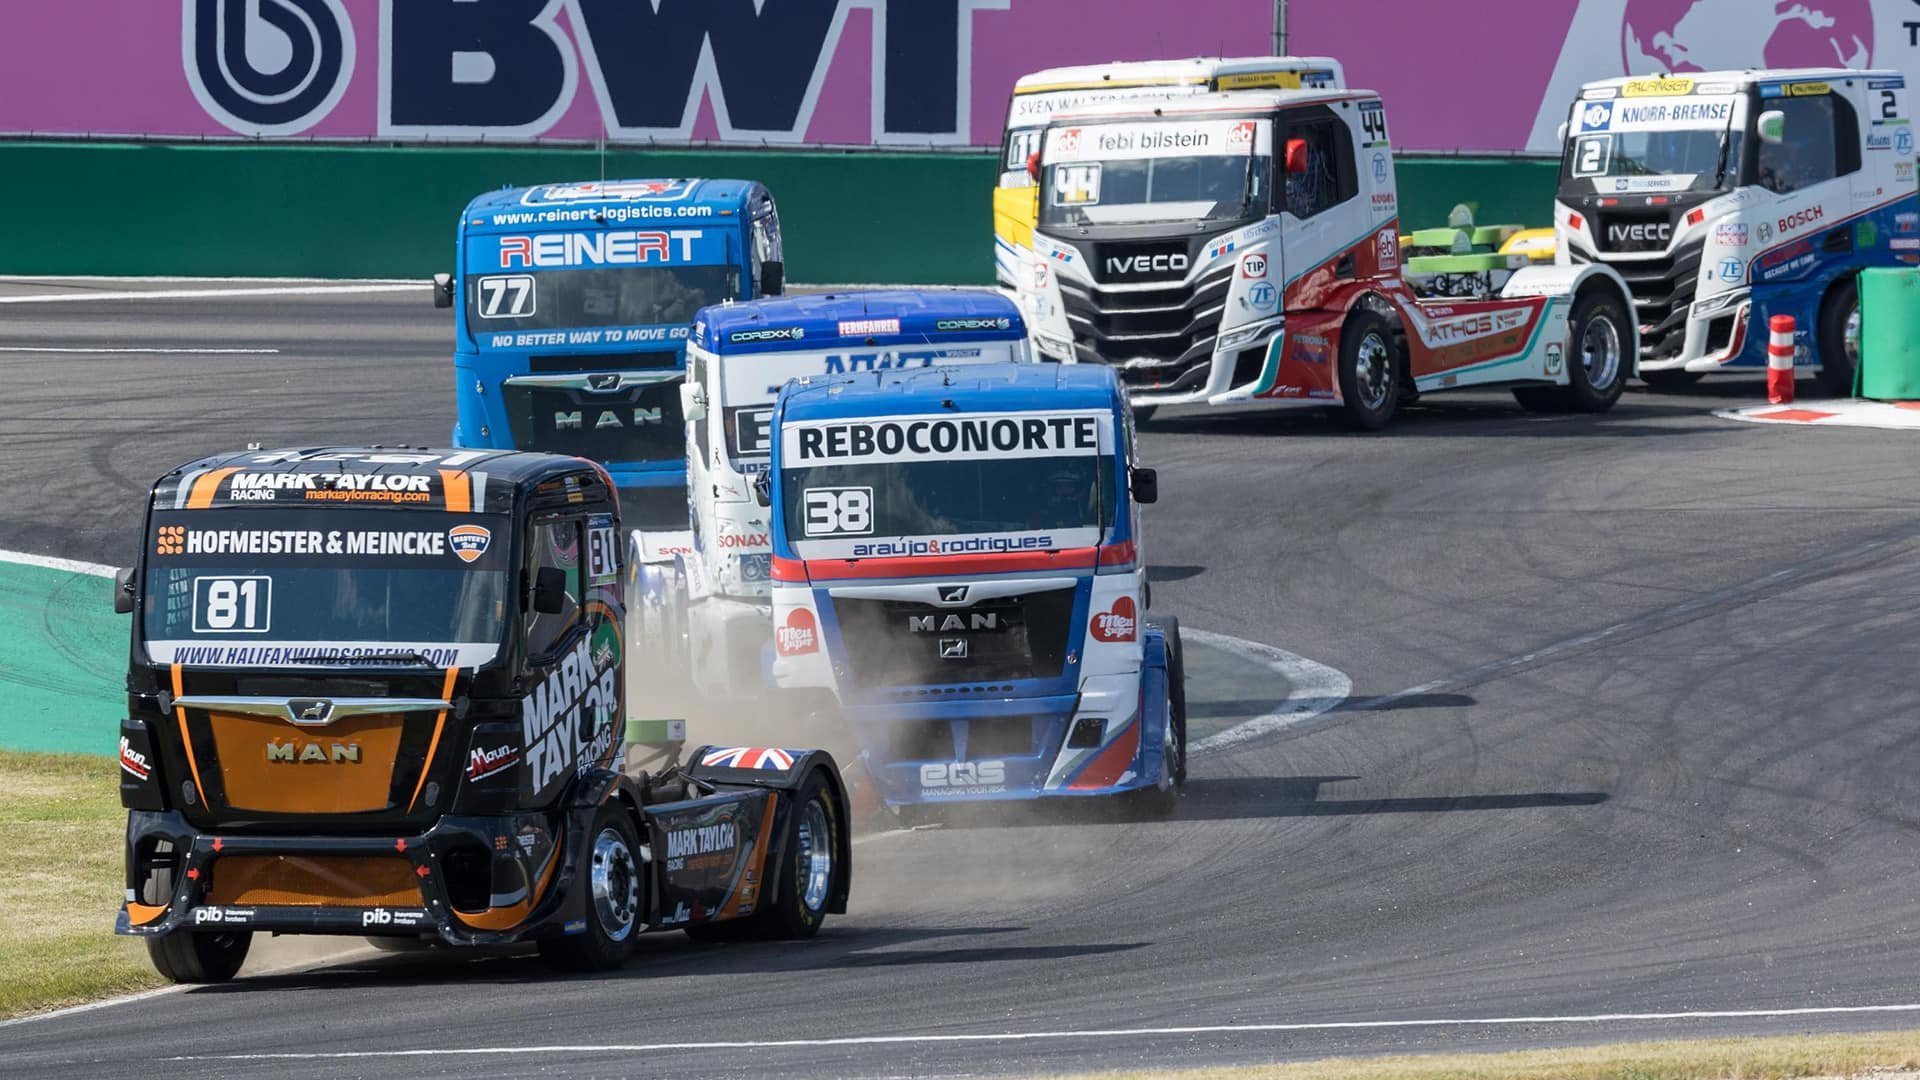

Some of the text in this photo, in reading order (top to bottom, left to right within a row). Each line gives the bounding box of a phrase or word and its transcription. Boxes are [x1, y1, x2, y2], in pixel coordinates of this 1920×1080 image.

[381, 0, 984, 137] BWT
[1019, 102, 1054, 115] SVEN
[1622, 103, 1728, 123] KNORR-BREMSE
[1881, 90, 1897, 118] 2
[1362, 111, 1386, 140] 44
[1098, 126, 1209, 151] febi bilstein
[1581, 141, 1600, 172] 2
[1058, 167, 1099, 202] 44
[493, 205, 713, 226] www.reinert-logistics.com
[1778, 205, 1824, 233] BOSCH
[500, 230, 703, 268] REINERT
[1107, 253, 1189, 274] IVECO
[1246, 261, 1265, 273] TIP
[482, 278, 531, 316] 77
[731, 329, 791, 342] COREXX
[839, 319, 900, 335] FERNFAHRER
[937, 319, 996, 330] COREXX
[1429, 315, 1492, 342] ATHOS
[492, 327, 689, 348] NO BETTER WAY TO MOVE GO
[1547, 352, 1560, 368] TIP
[555, 406, 663, 431] MAN
[799, 416, 1098, 460] REBOCONORTE
[231, 474, 430, 491] MARK TAYLOR
[230, 488, 430, 504] RACING marktaylorracing.com
[807, 489, 871, 534] 38
[187, 530, 445, 555] HOFMEISTER & MEINCKE
[590, 529, 613, 575] 81
[659, 546, 692, 555] SON
[719, 533, 770, 549] SONAX
[854, 534, 1053, 556] araújo&rodrigues
[207, 580, 257, 628] 81
[909, 612, 998, 632] MAN
[522, 630, 597, 747] MARK
[526, 668, 618, 796] TAYLOR
[266, 743, 359, 762] MAN
[466, 744, 511, 771] Maun
[576, 725, 612, 769] RACING
[667, 822, 735, 858] MARK TAYLOR
[195, 907, 223, 925] pib
[363, 907, 391, 927] pib
